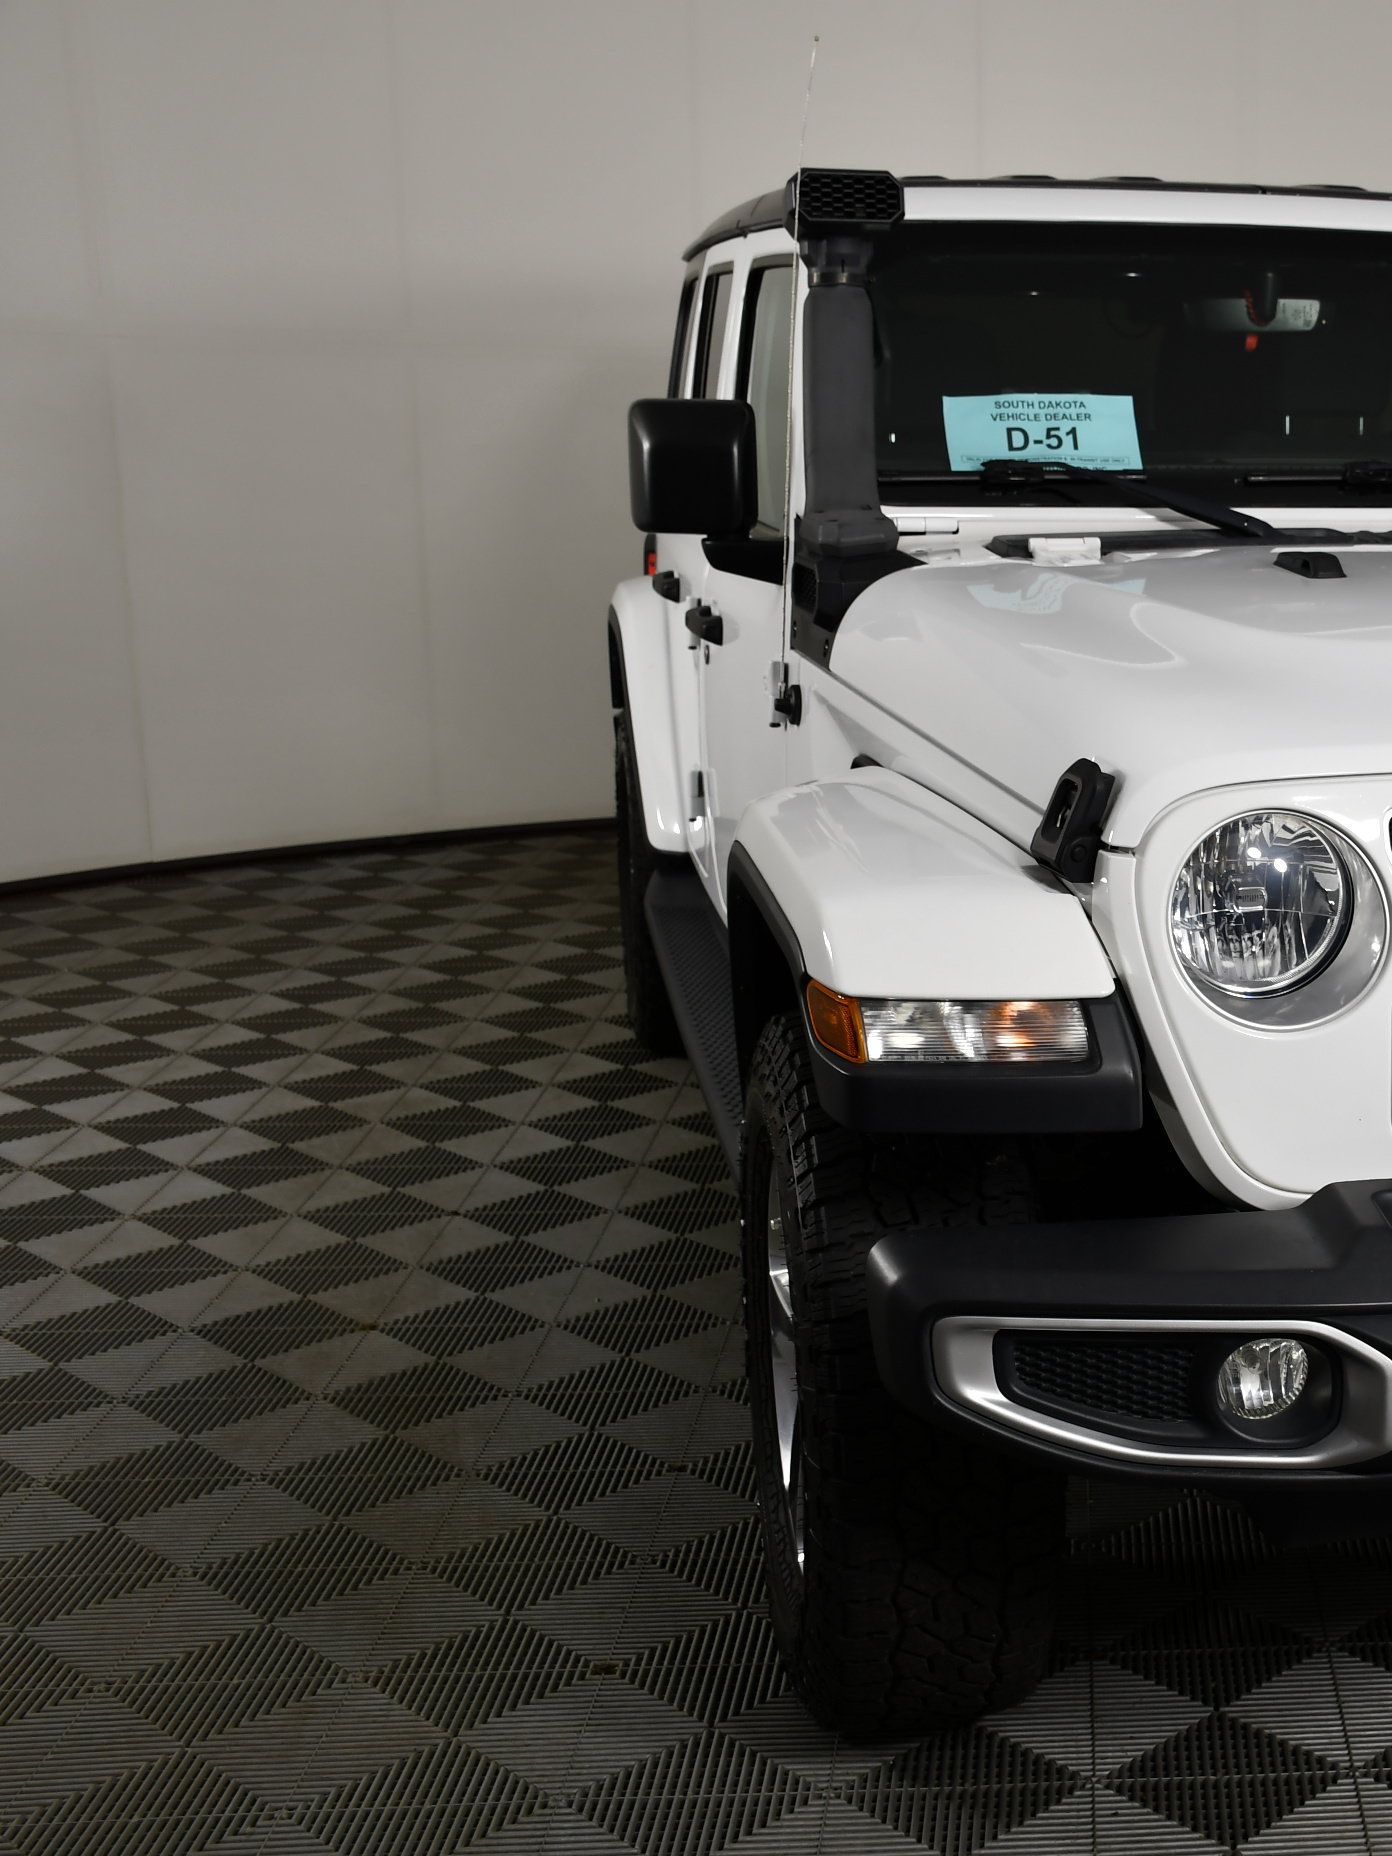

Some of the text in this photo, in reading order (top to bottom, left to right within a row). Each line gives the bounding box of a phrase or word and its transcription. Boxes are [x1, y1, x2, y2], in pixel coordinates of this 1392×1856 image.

[994, 400, 1086, 409] SOUTH DAKOTA
[990, 412, 1092, 422] VEHICLE DEALER
[1006, 426, 1079, 452] D-51
